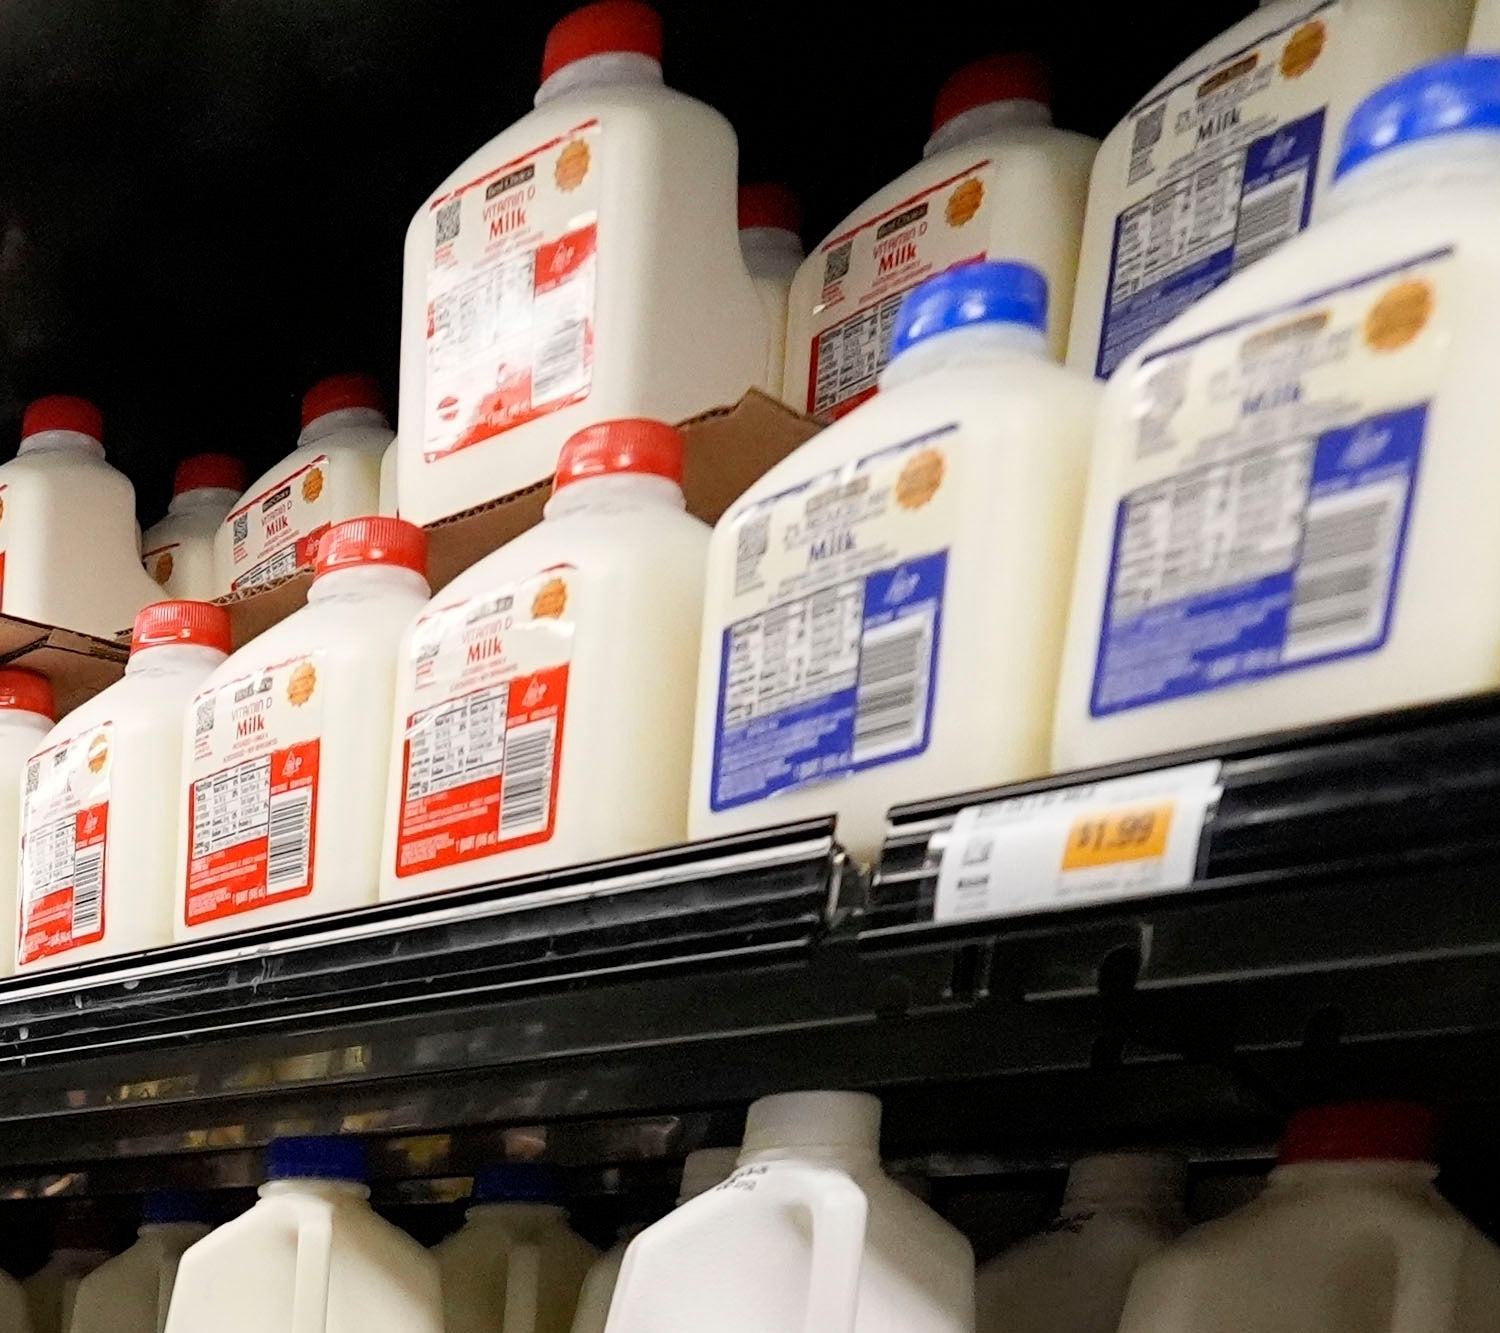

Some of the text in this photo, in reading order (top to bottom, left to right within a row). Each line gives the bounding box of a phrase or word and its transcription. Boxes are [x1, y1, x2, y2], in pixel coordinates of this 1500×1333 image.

[489, 208, 526, 240] Milk
[878, 243, 917, 275] Milk
[467, 638, 502, 665] Milk
[236, 715, 265, 740] Milk
